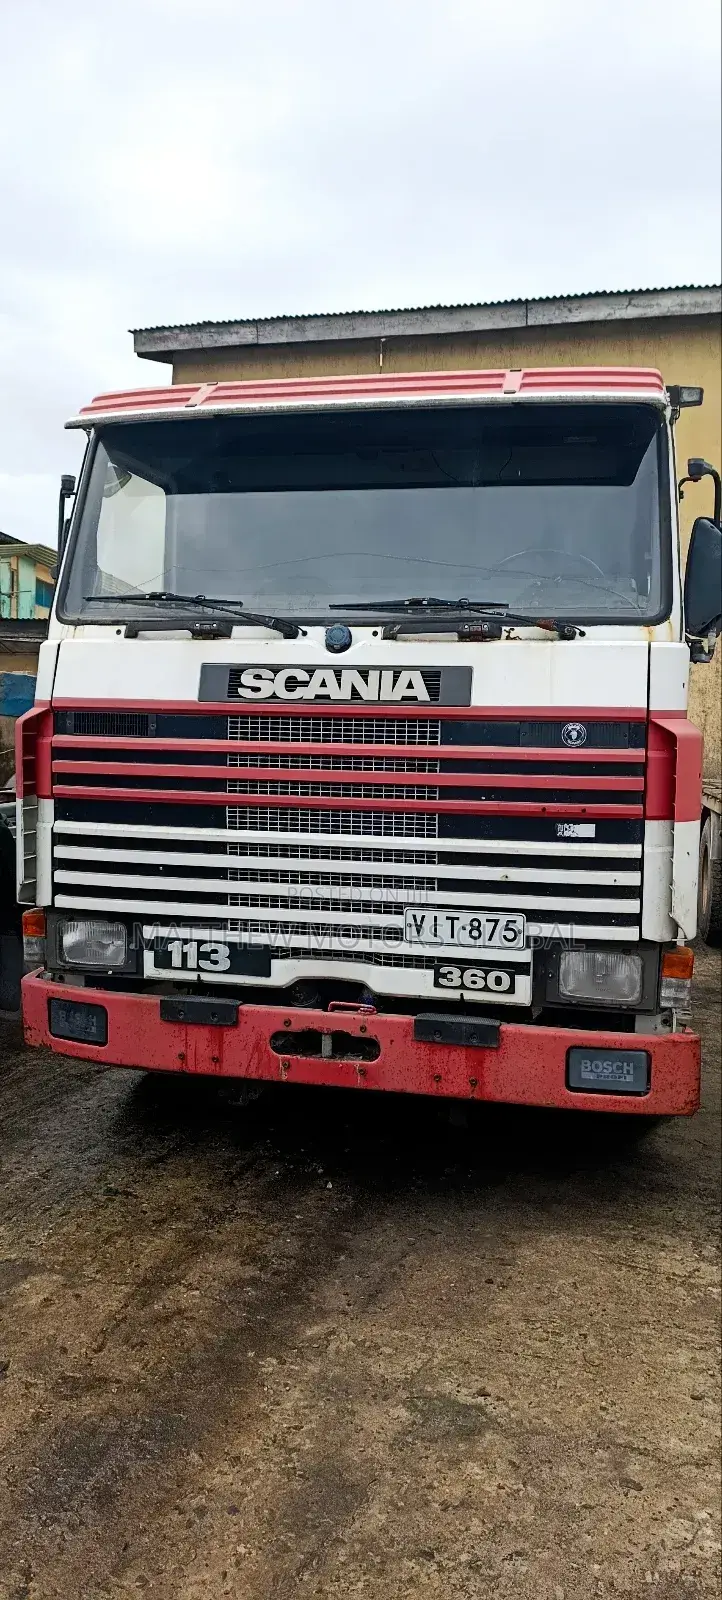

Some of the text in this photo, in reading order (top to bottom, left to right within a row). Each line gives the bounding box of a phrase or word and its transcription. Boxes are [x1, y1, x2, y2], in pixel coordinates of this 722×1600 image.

[237, 668, 430, 702] SCANIA
[167, 940, 230, 972] 113
[438, 966, 511, 992] 360
[581, 1060, 633, 1074] BOSCH
